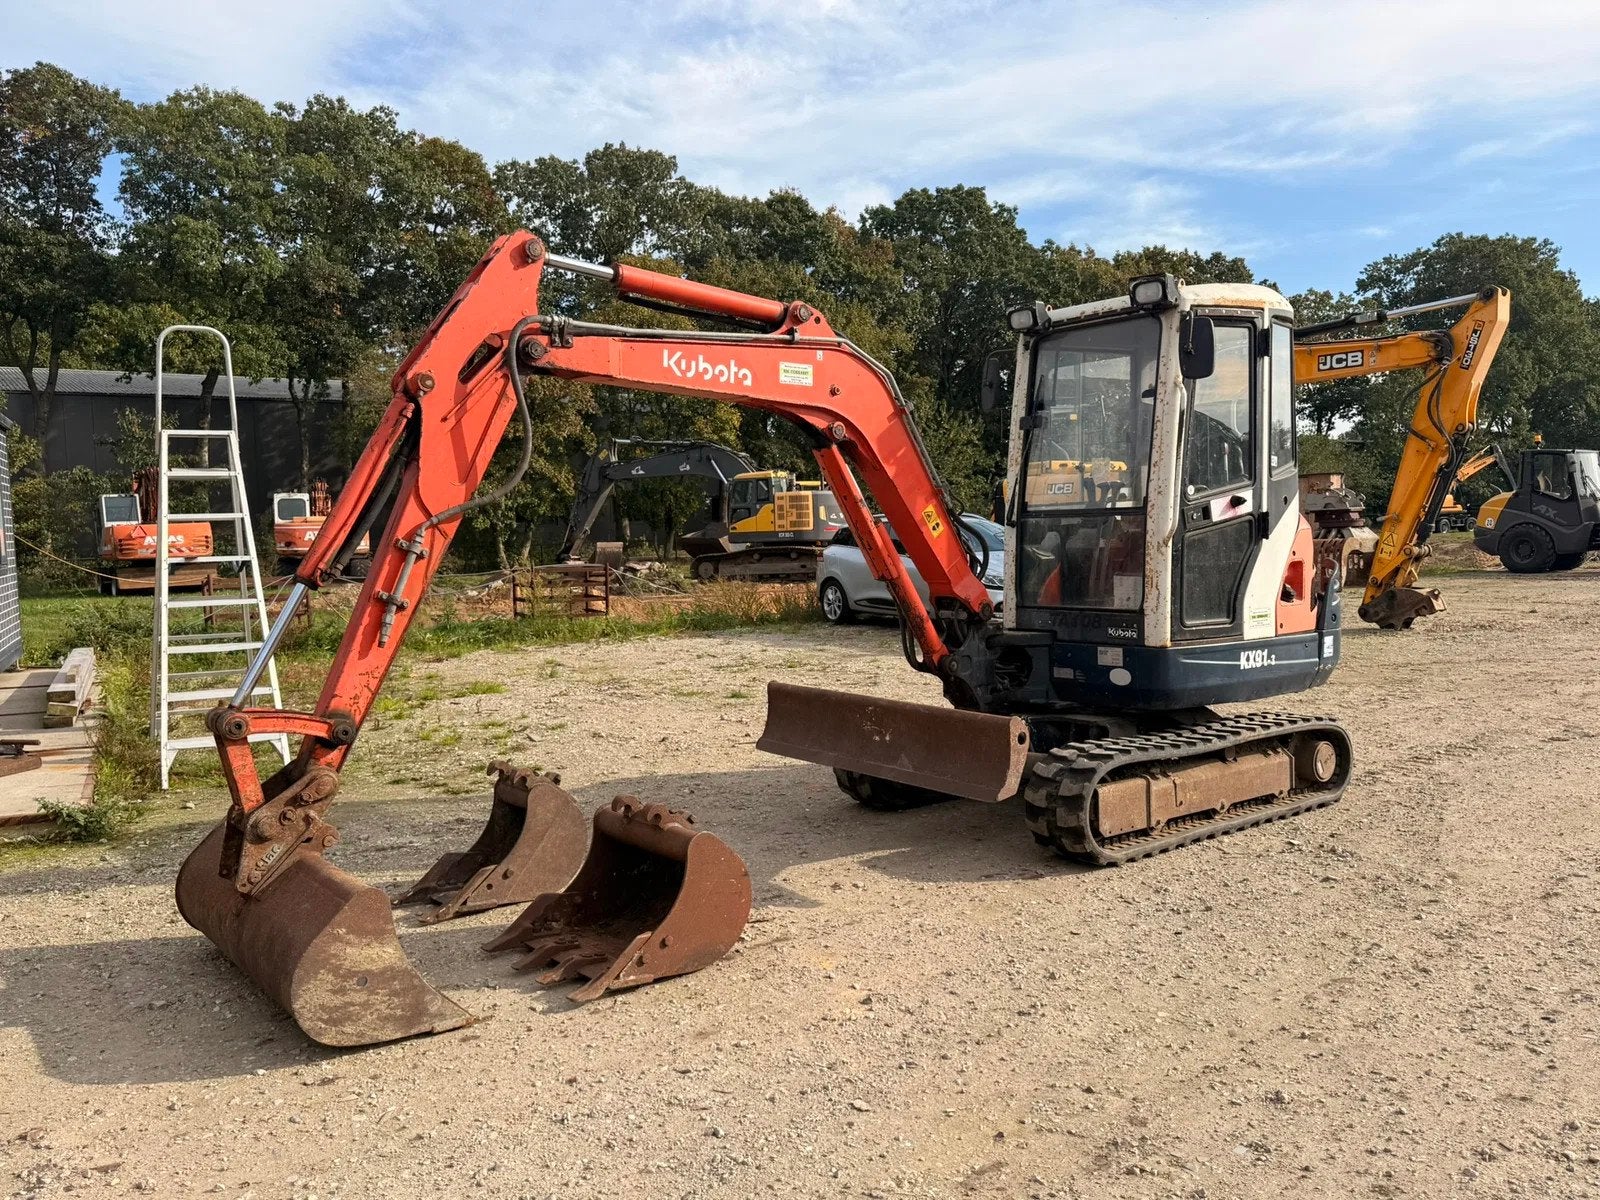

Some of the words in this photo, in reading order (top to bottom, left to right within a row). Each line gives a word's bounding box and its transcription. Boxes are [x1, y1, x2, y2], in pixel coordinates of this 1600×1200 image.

[1319, 351, 1363, 370] JCB
[663, 348, 753, 387] Kubota
[1047, 483, 1073, 494] JCB
[143, 534, 185, 546] ATAS
[1108, 627, 1137, 638] Kubota
